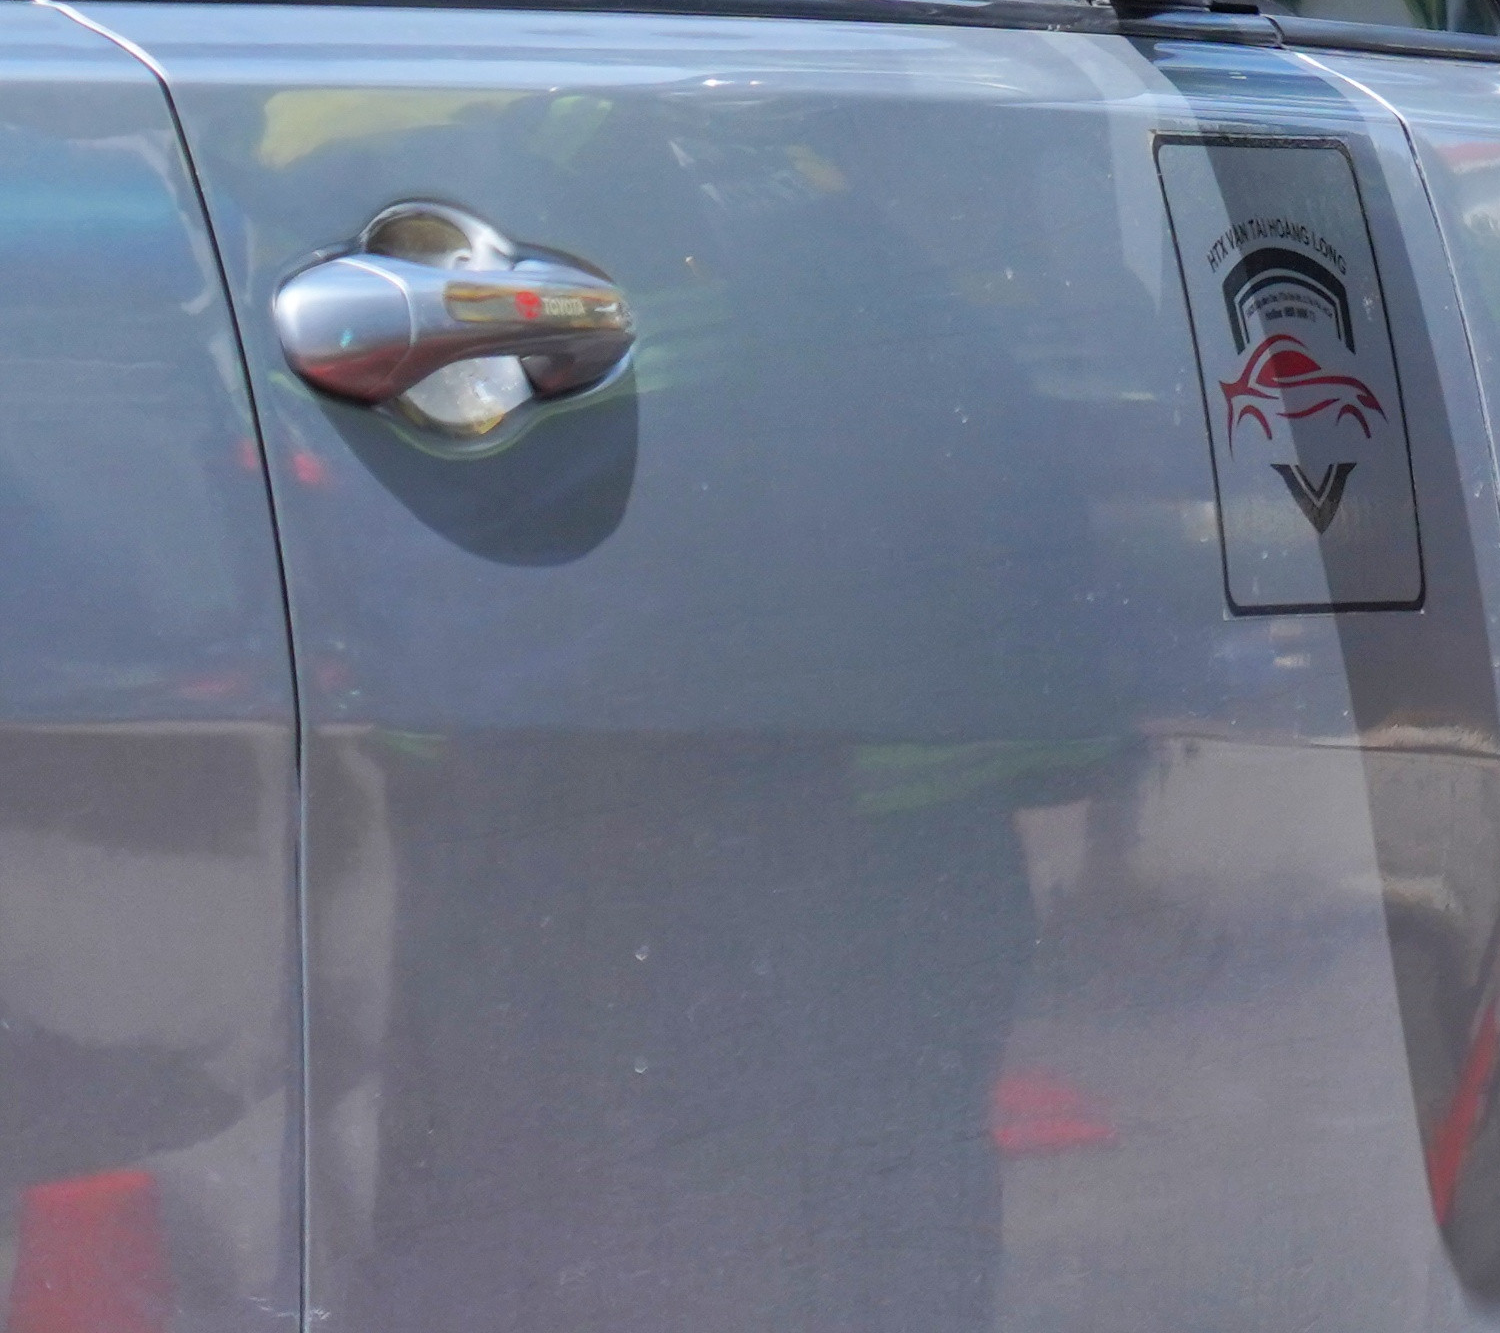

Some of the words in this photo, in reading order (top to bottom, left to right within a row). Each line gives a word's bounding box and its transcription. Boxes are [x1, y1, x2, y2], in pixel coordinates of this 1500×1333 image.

[1206, 236, 1229, 273] HTX
[1311, 230, 1347, 275] LONG
[541, 297, 586, 316] TOYOTA
